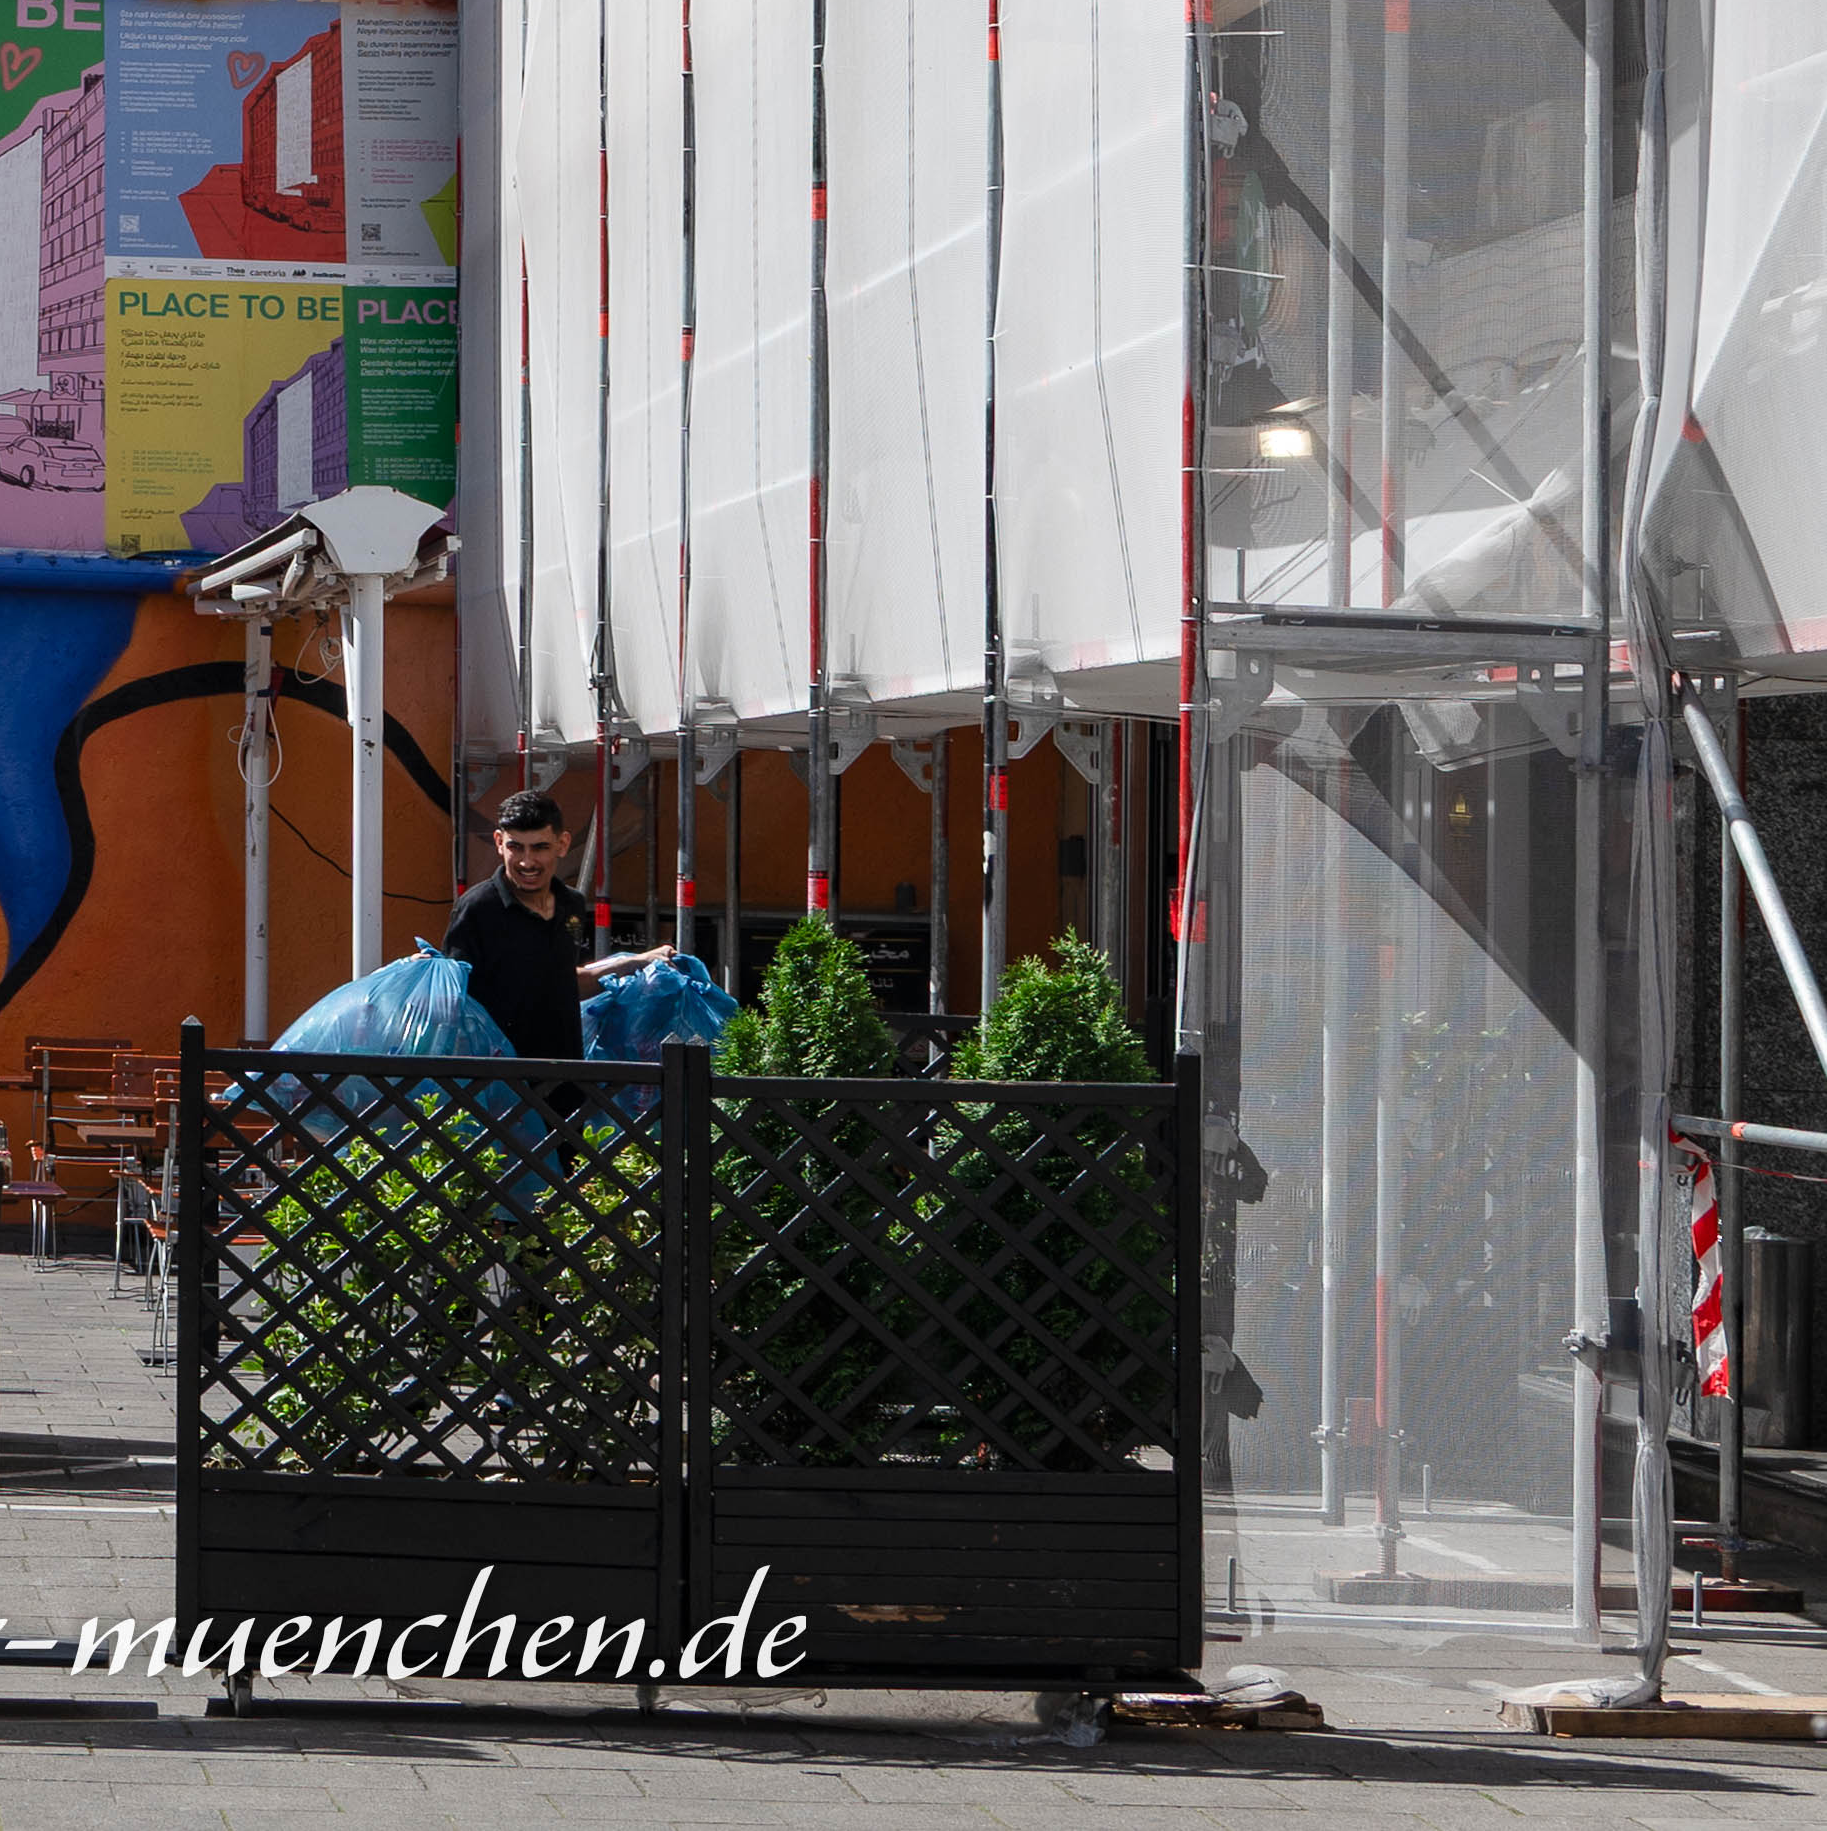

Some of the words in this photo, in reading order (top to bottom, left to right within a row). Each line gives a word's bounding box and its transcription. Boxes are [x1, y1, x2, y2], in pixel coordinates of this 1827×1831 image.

[119, 292, 229, 318] PLACE
[239, 295, 285, 319] TO
[298, 297, 340, 321] BE
